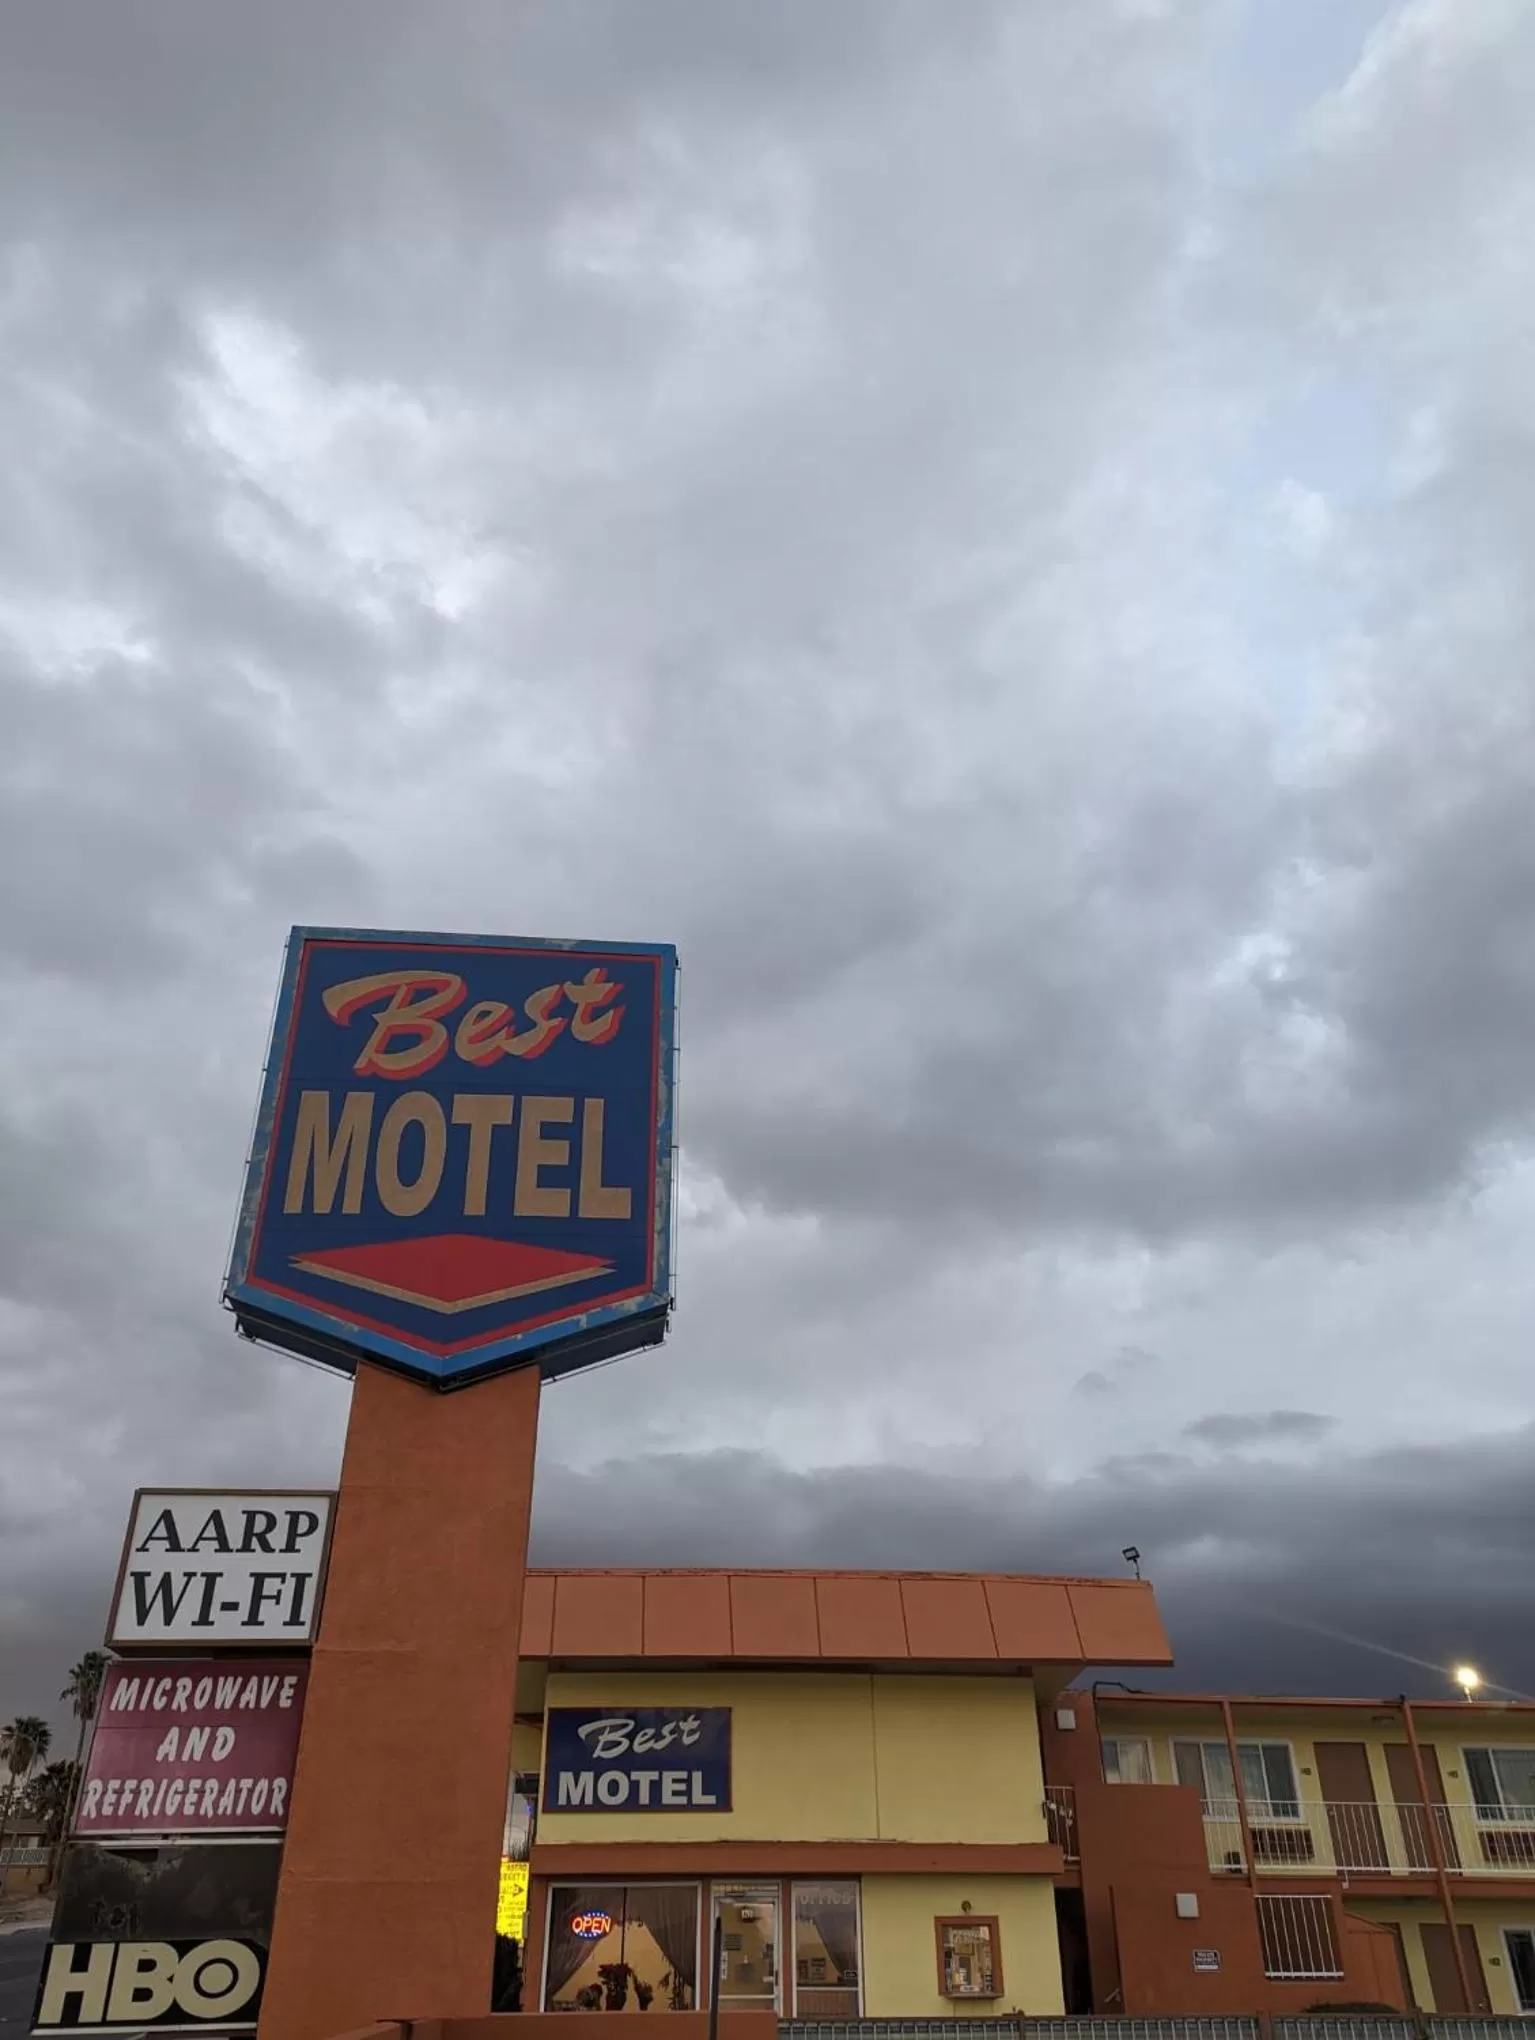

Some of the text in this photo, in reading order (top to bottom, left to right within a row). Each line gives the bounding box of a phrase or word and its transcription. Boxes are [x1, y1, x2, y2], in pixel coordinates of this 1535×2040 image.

[322, 968, 625, 1080] Best
[283, 1090, 632, 1220] MOTEL
[135, 1509, 319, 1553] AARP
[130, 1571, 313, 1626] WI-FI
[109, 1676, 298, 1712] MICROWAVE
[155, 1726, 236, 1762] AND
[577, 1714, 701, 1759] Best
[82, 1777, 288, 1819] REFRIGERATOR
[558, 1770, 717, 1806] MOTEL
[572, 1916, 611, 1934] OPEN
[38, 1939, 260, 2024] HBO
